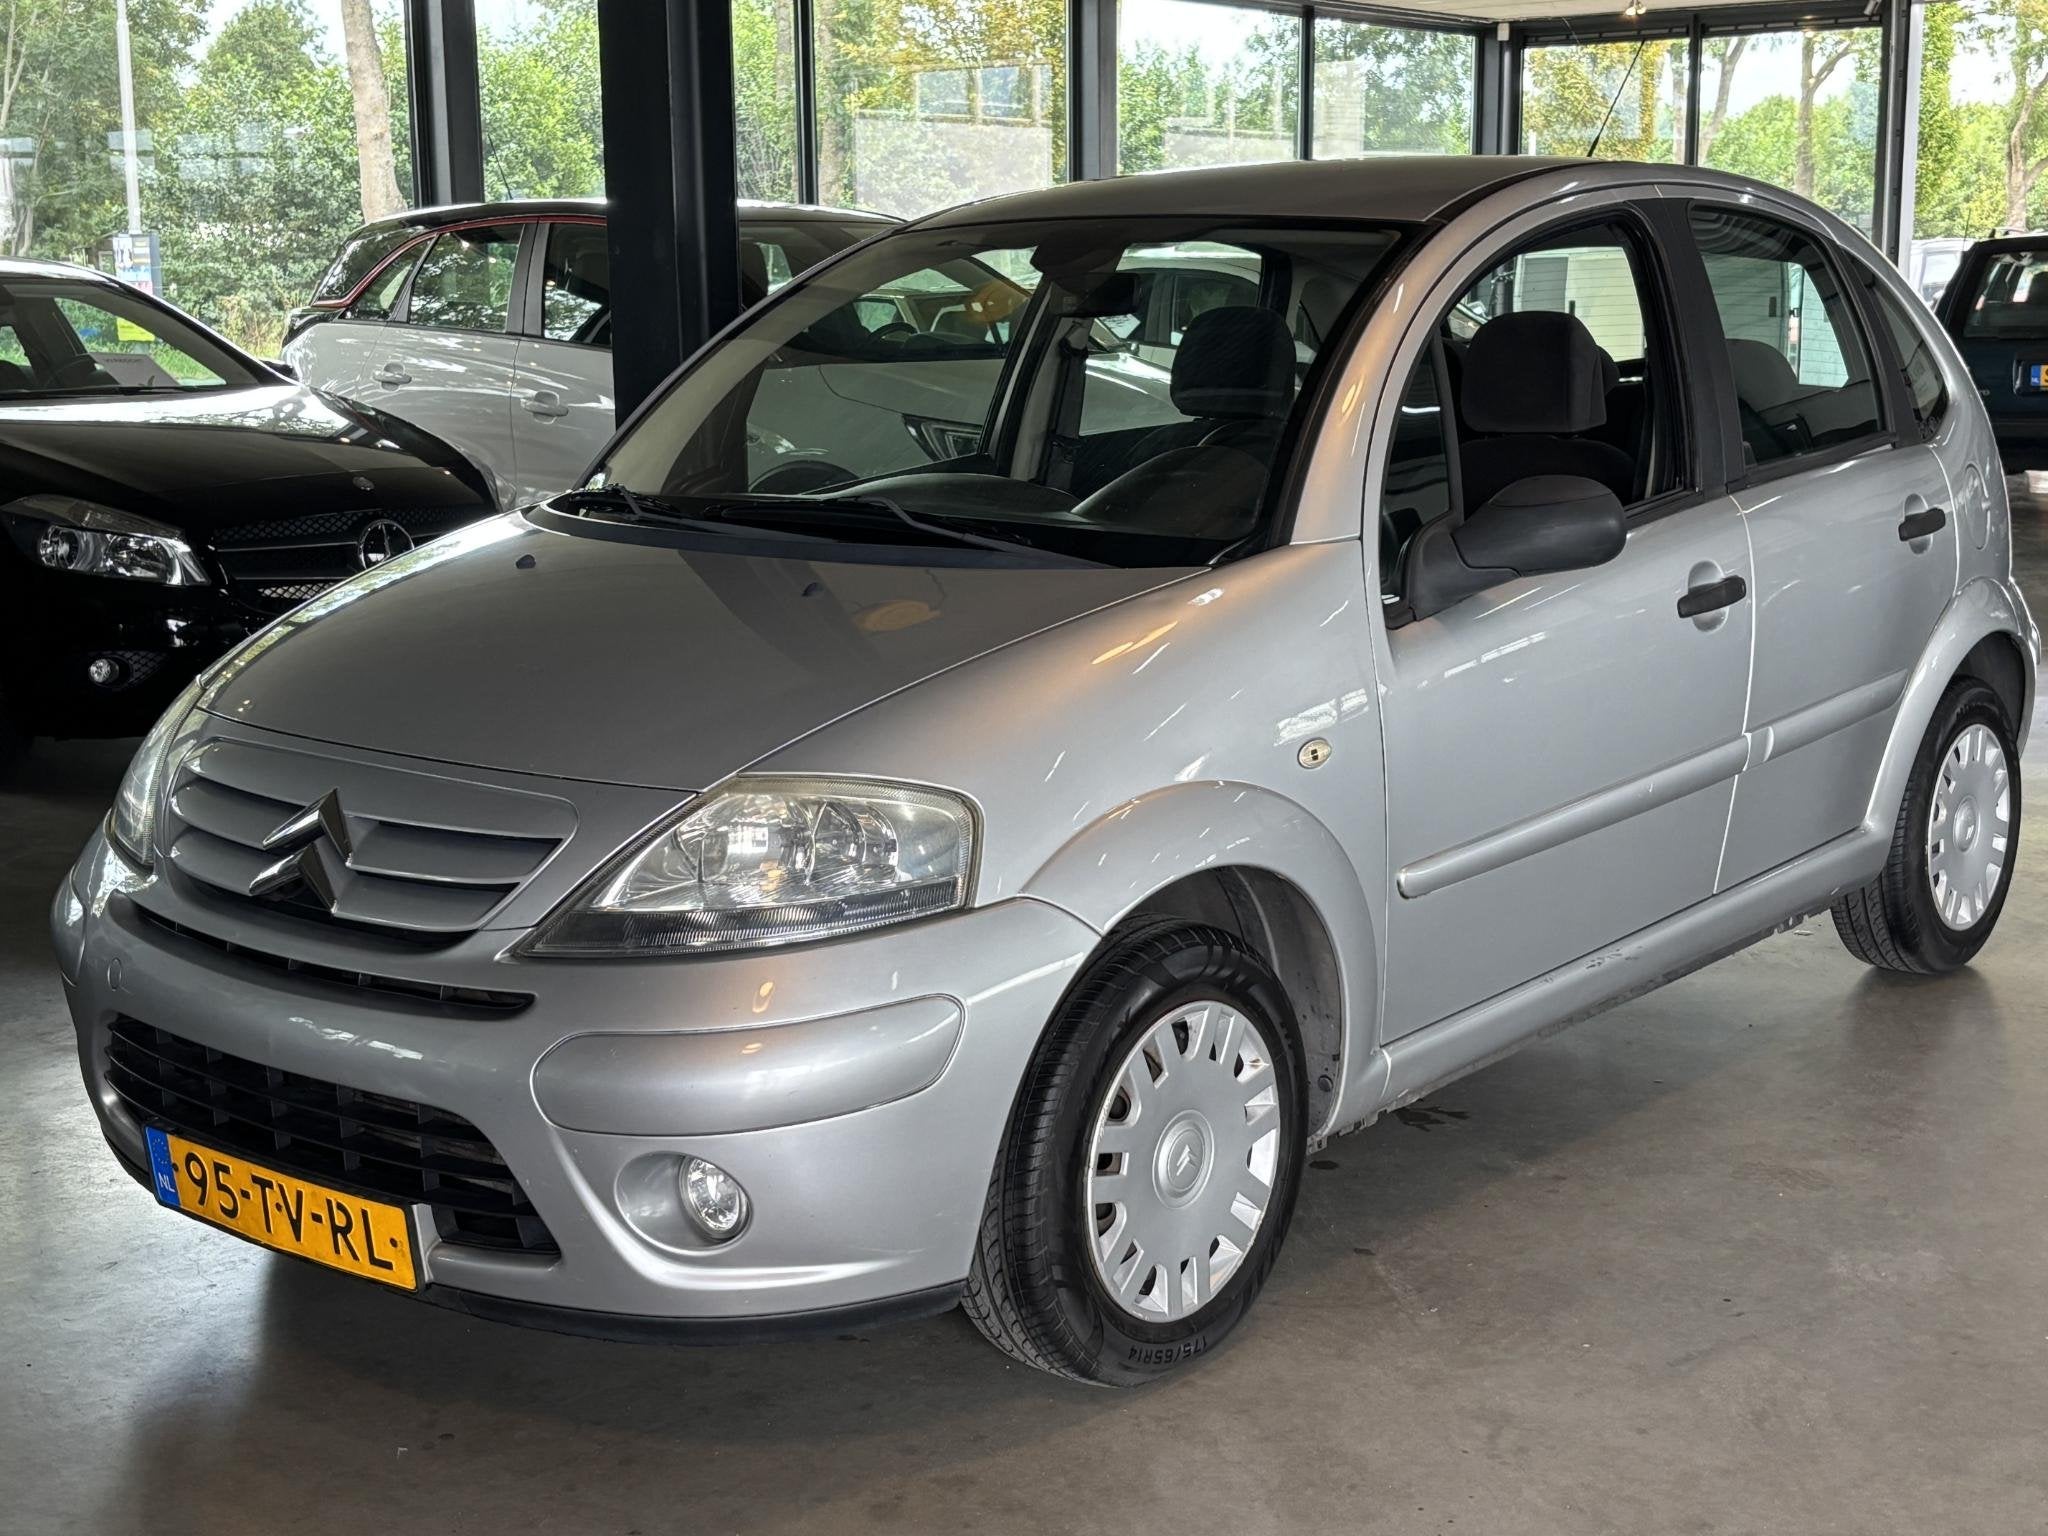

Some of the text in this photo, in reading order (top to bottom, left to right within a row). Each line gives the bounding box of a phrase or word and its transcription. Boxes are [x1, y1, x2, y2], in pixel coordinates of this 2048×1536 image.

[158, 1172, 176, 1194] NL
[184, 1151, 394, 1271] 95-TV-RL
[1128, 1336, 1208, 1364] 175/65R14
